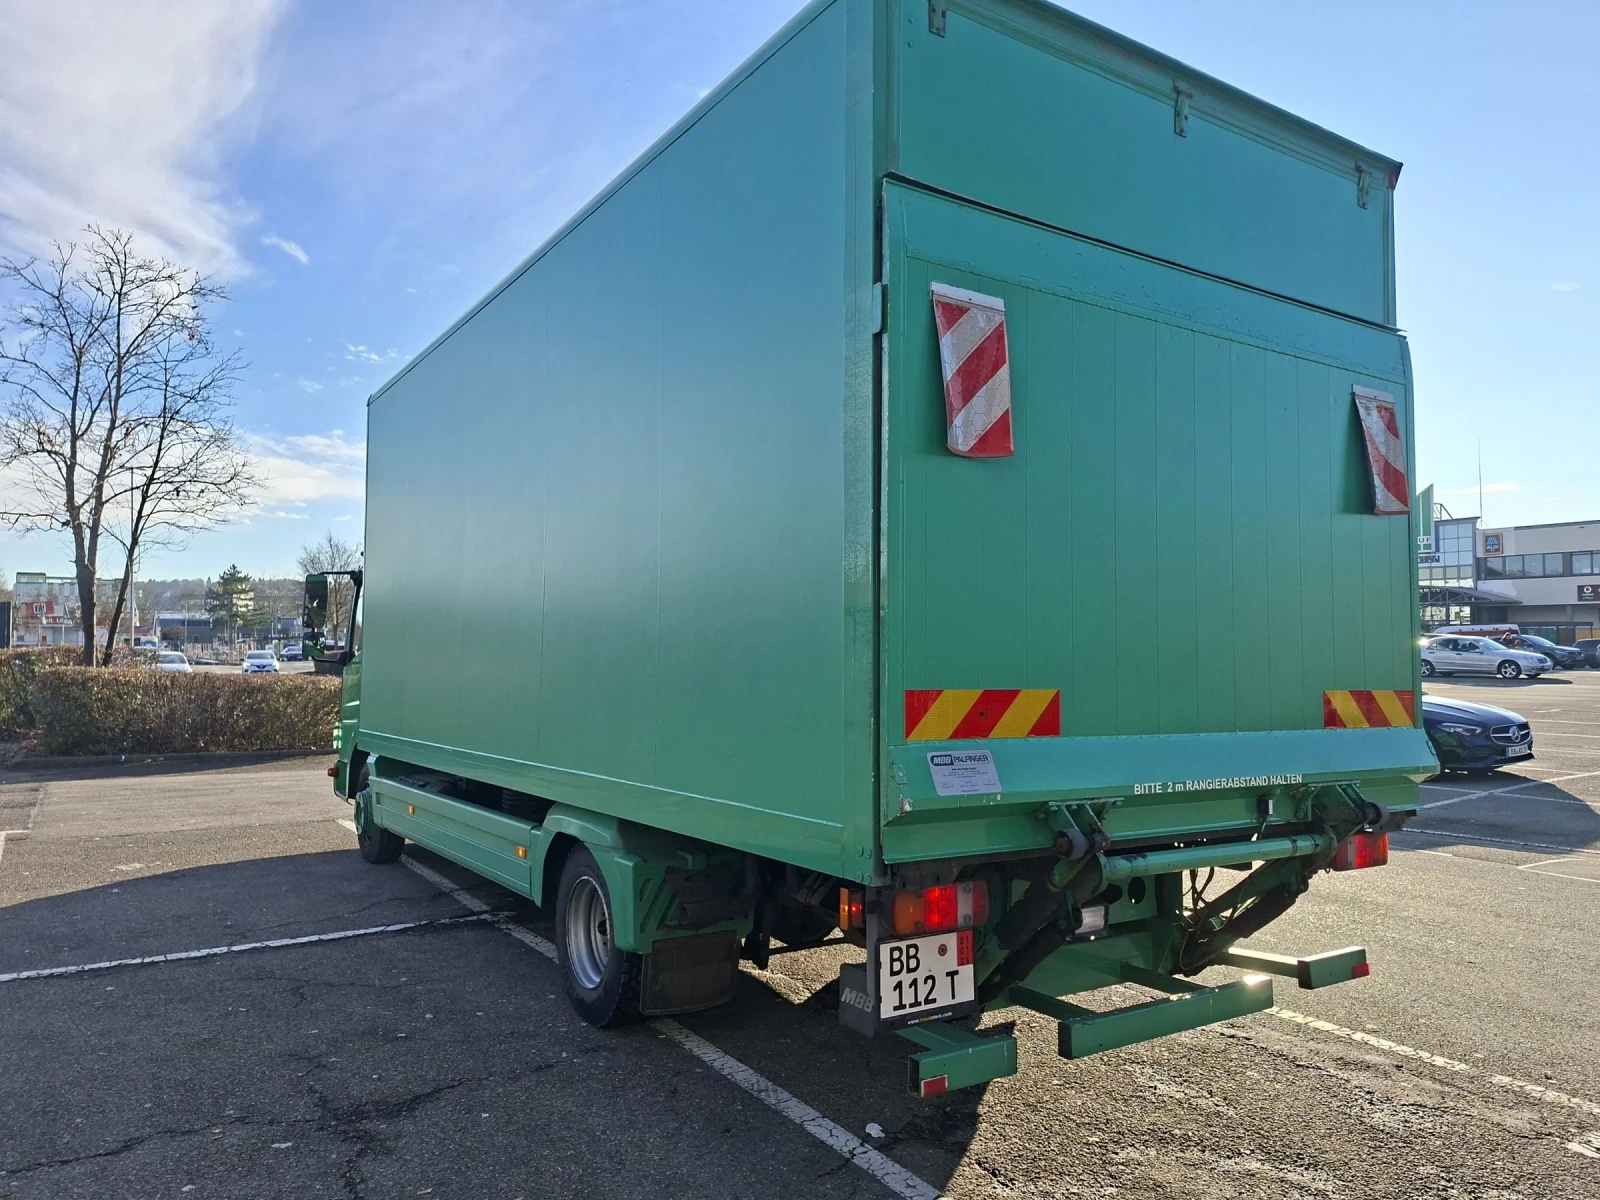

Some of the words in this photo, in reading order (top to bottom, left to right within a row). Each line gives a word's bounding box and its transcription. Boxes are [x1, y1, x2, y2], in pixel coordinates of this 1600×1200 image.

[933, 756, 951, 764] MBB
[953, 754, 989, 763] PALFINGER
[1134, 782, 1162, 795] BITTE
[1167, 782, 1173, 793] 2
[1175, 783, 1184, 792] m
[1186, 775, 1268, 791] RANGIERABSTAND
[1270, 773, 1302, 786] HALTEN
[889, 943, 921, 977] BB
[841, 987, 874, 1013] MBB
[892, 974, 937, 1012] 112
[945, 969, 960, 1000] T
